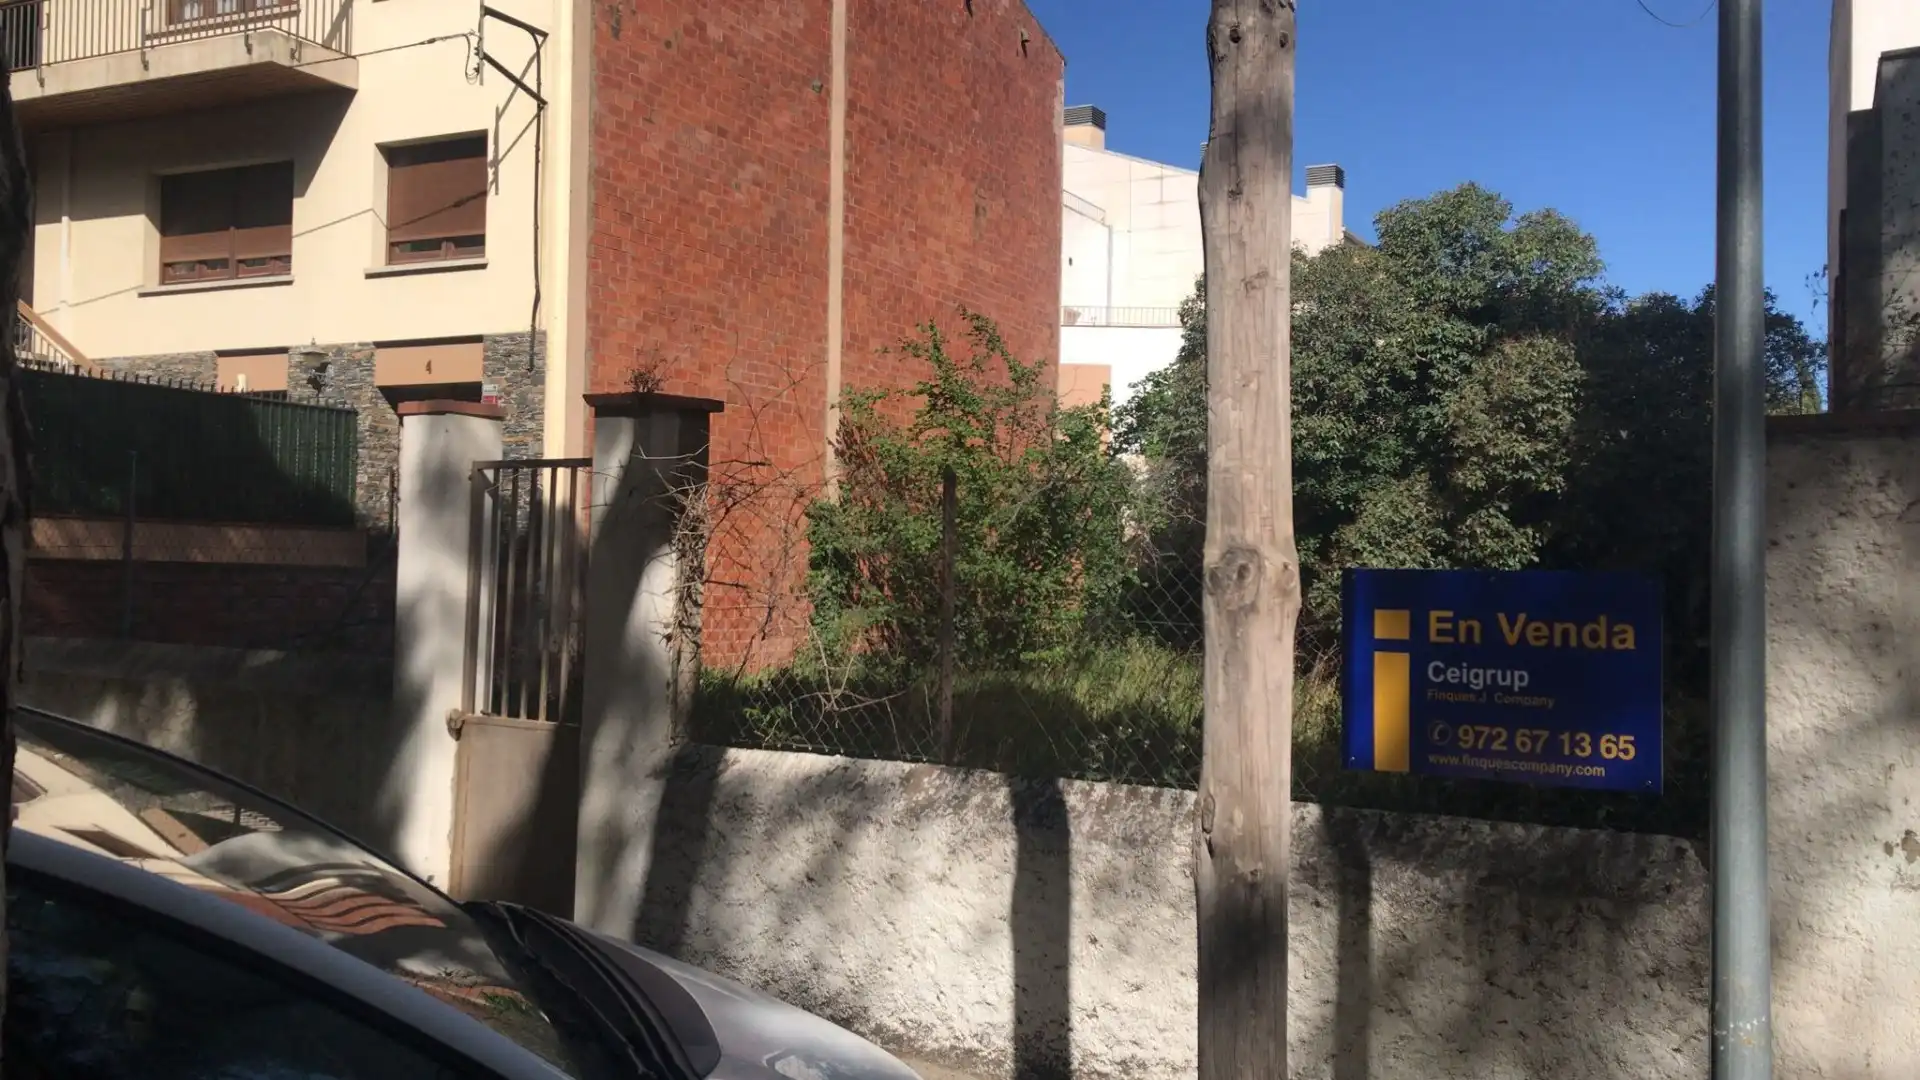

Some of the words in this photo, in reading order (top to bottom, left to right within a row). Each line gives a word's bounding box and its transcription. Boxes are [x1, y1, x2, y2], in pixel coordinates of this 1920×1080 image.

[1428, 610, 1481, 644] En
[1496, 612, 1636, 650] Venda
[1427, 660, 1529, 692] Ceigrup
[1427, 688, 1476, 704] Finques
[1493, 692, 1555, 709] Company
[1457, 724, 1508, 751] 972
[1515, 728, 1549, 754] 67
[1558, 731, 1592, 758] 13
[1599, 733, 1636, 760] 65
[1428, 753, 1606, 777] www.finquescompany.com
